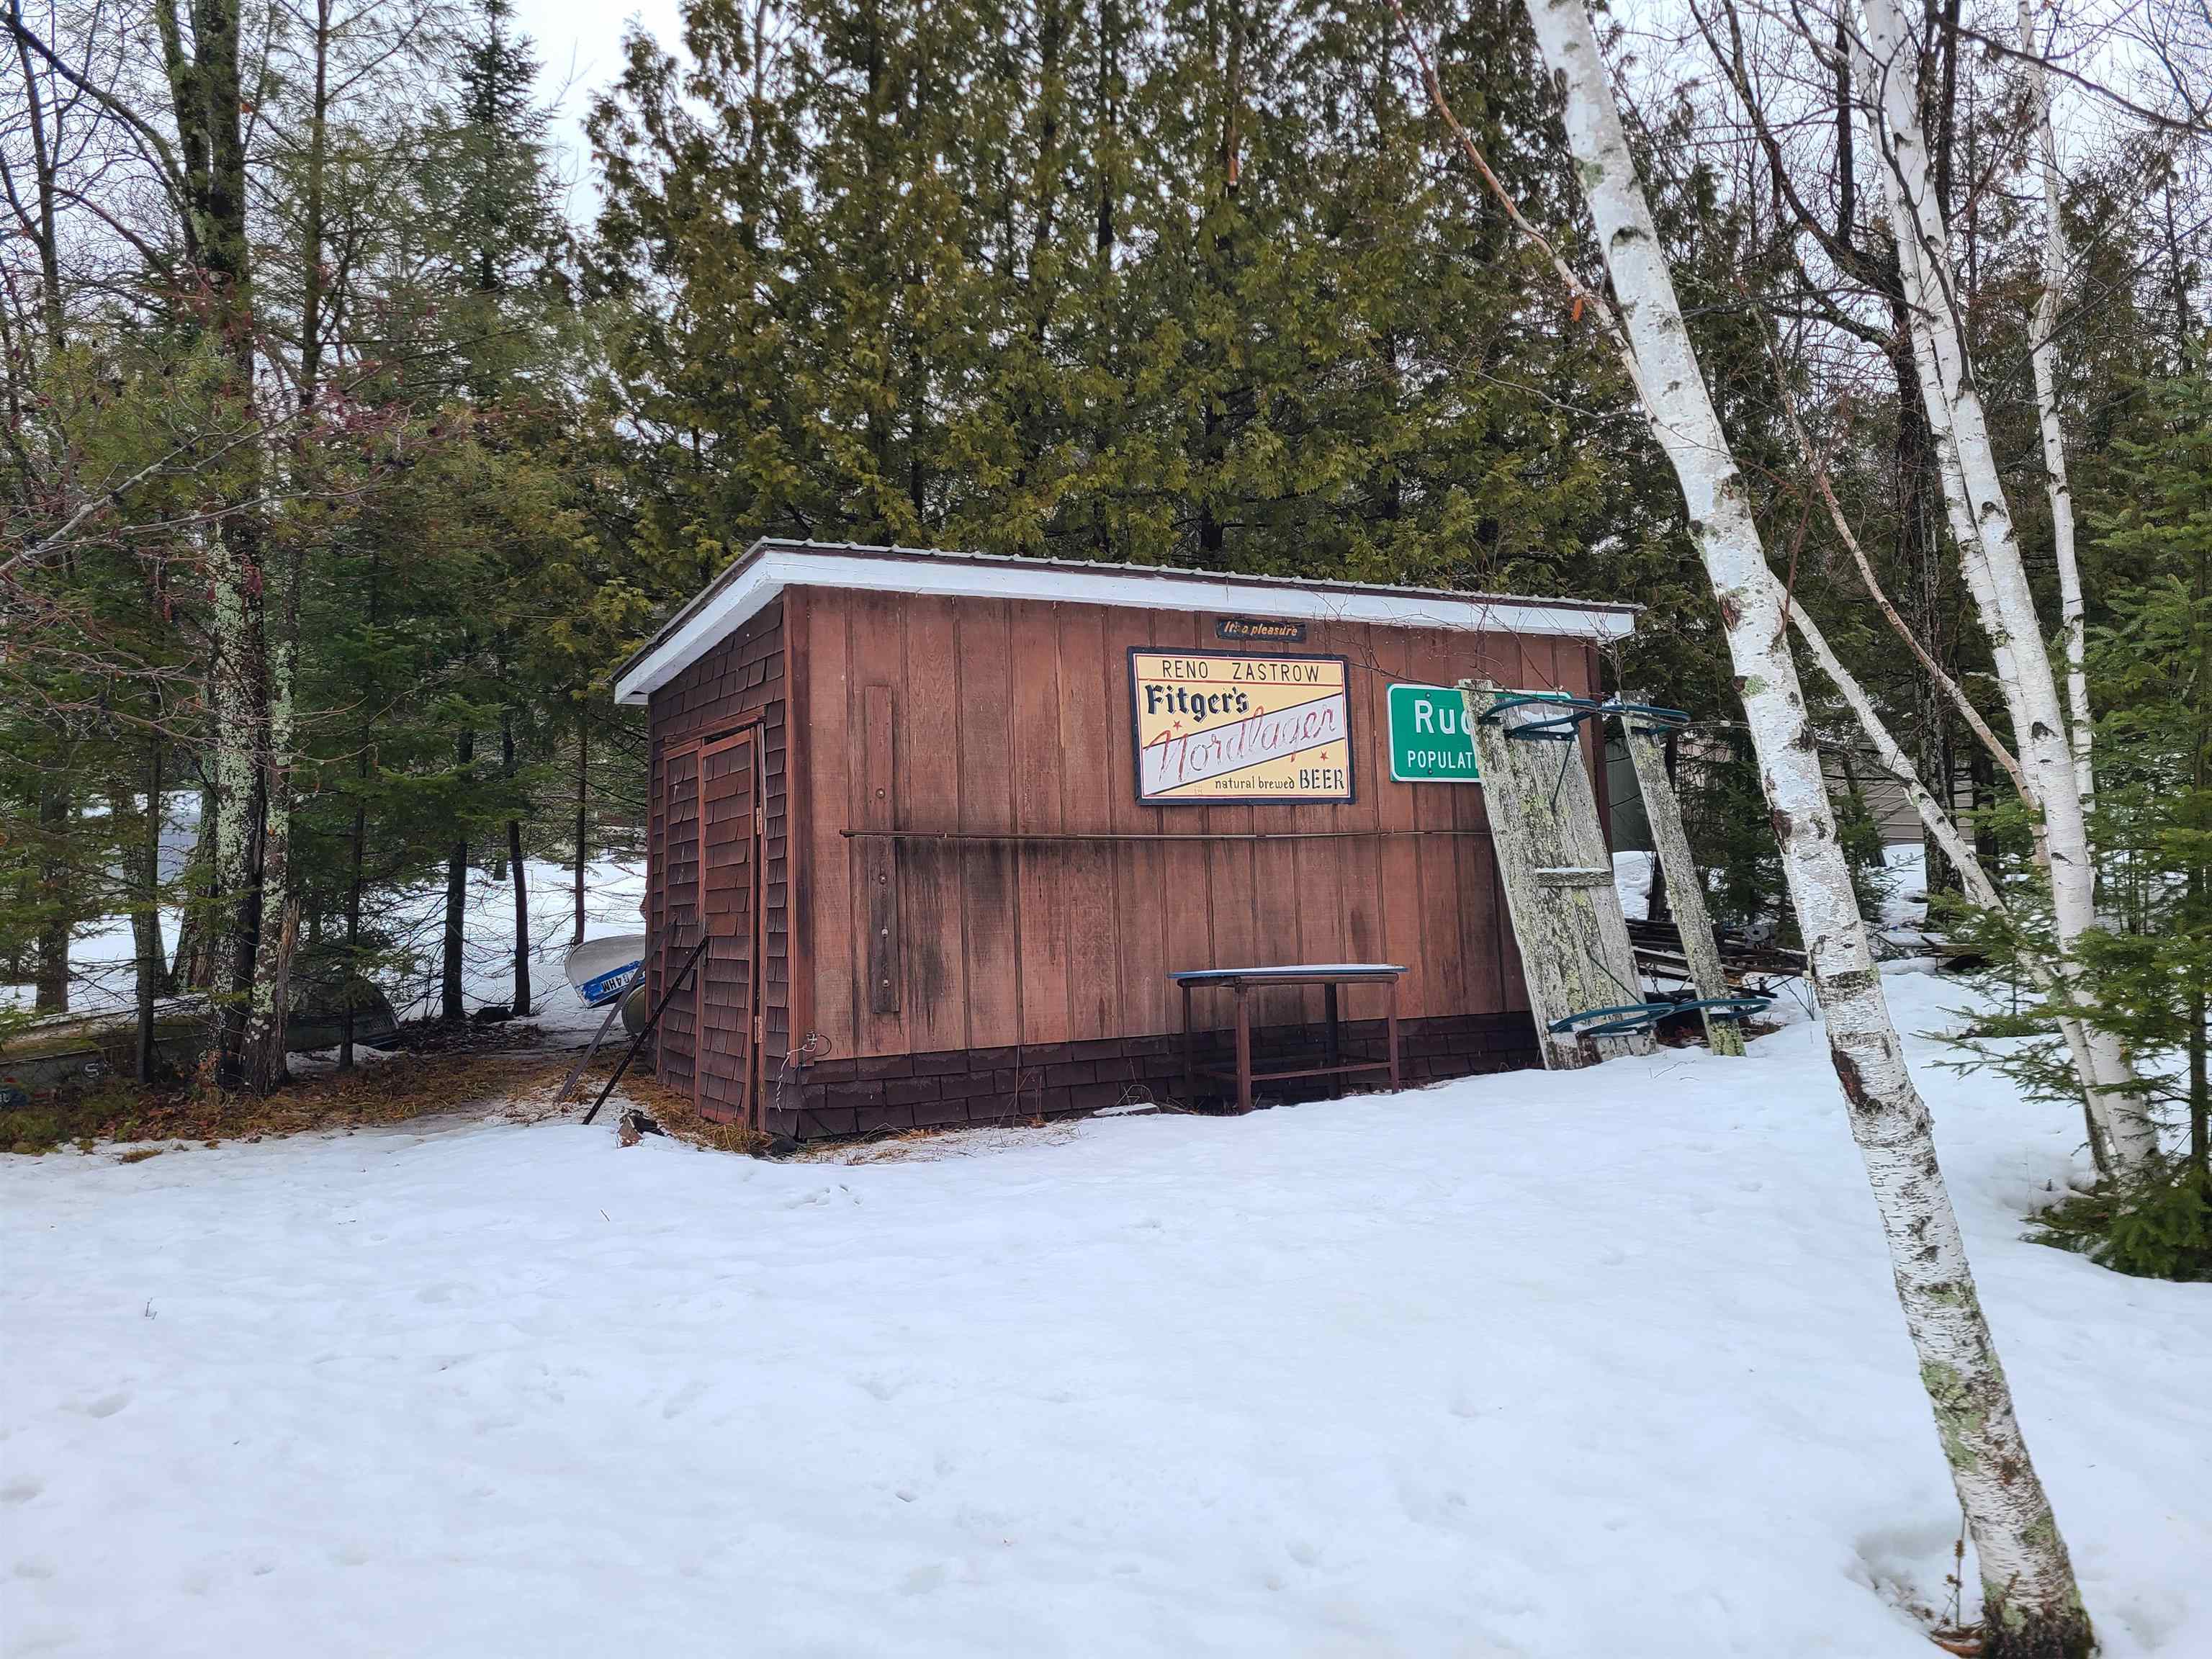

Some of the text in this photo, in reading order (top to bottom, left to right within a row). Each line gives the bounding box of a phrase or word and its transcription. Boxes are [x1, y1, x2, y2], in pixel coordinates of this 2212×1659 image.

[1224, 620, 1240, 633] It's
[1249, 623, 1298, 637] pleasure
[1161, 660, 1320, 683] RENO ZASTROW
[1145, 684, 1250, 723] Fitger's
[1146, 706, 1336, 783] Nordlager
[1215, 776, 1256, 790] natural
[1257, 776, 1295, 790] brewed
[1299, 768, 1345, 791] BEER
